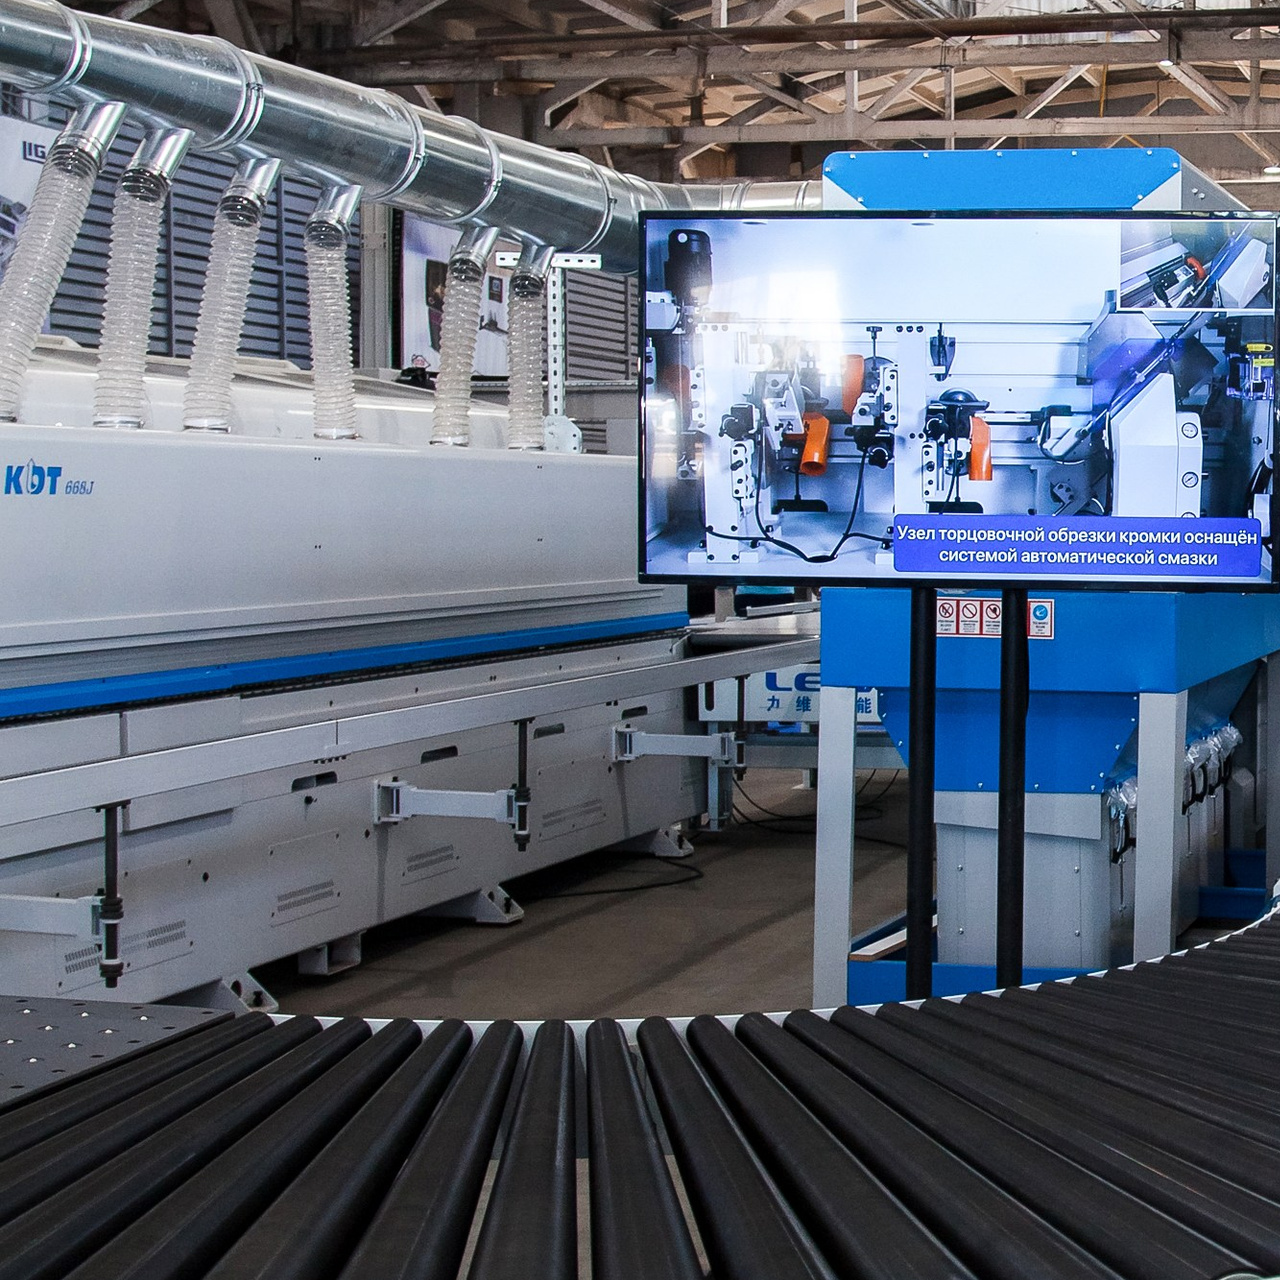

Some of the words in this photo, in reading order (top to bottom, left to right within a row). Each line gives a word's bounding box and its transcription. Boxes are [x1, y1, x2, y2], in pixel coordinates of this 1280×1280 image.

[23, 141, 46, 164] LIG
[4, 460, 62, 495] KDT
[65, 481, 94, 495] 668J
[897, 525, 936, 541] Узел
[939, 527, 1045, 543] торцовочной
[1048, 528, 1116, 545] обрезки
[1119, 531, 1181, 545] кромки
[1184, 530, 1258, 546] оснащён
[939, 548, 1018, 563] системой
[1021, 549, 1155, 565] автоматической
[1158, 553, 1218, 566] смазки
[767, 695, 872, 714] 力维能
